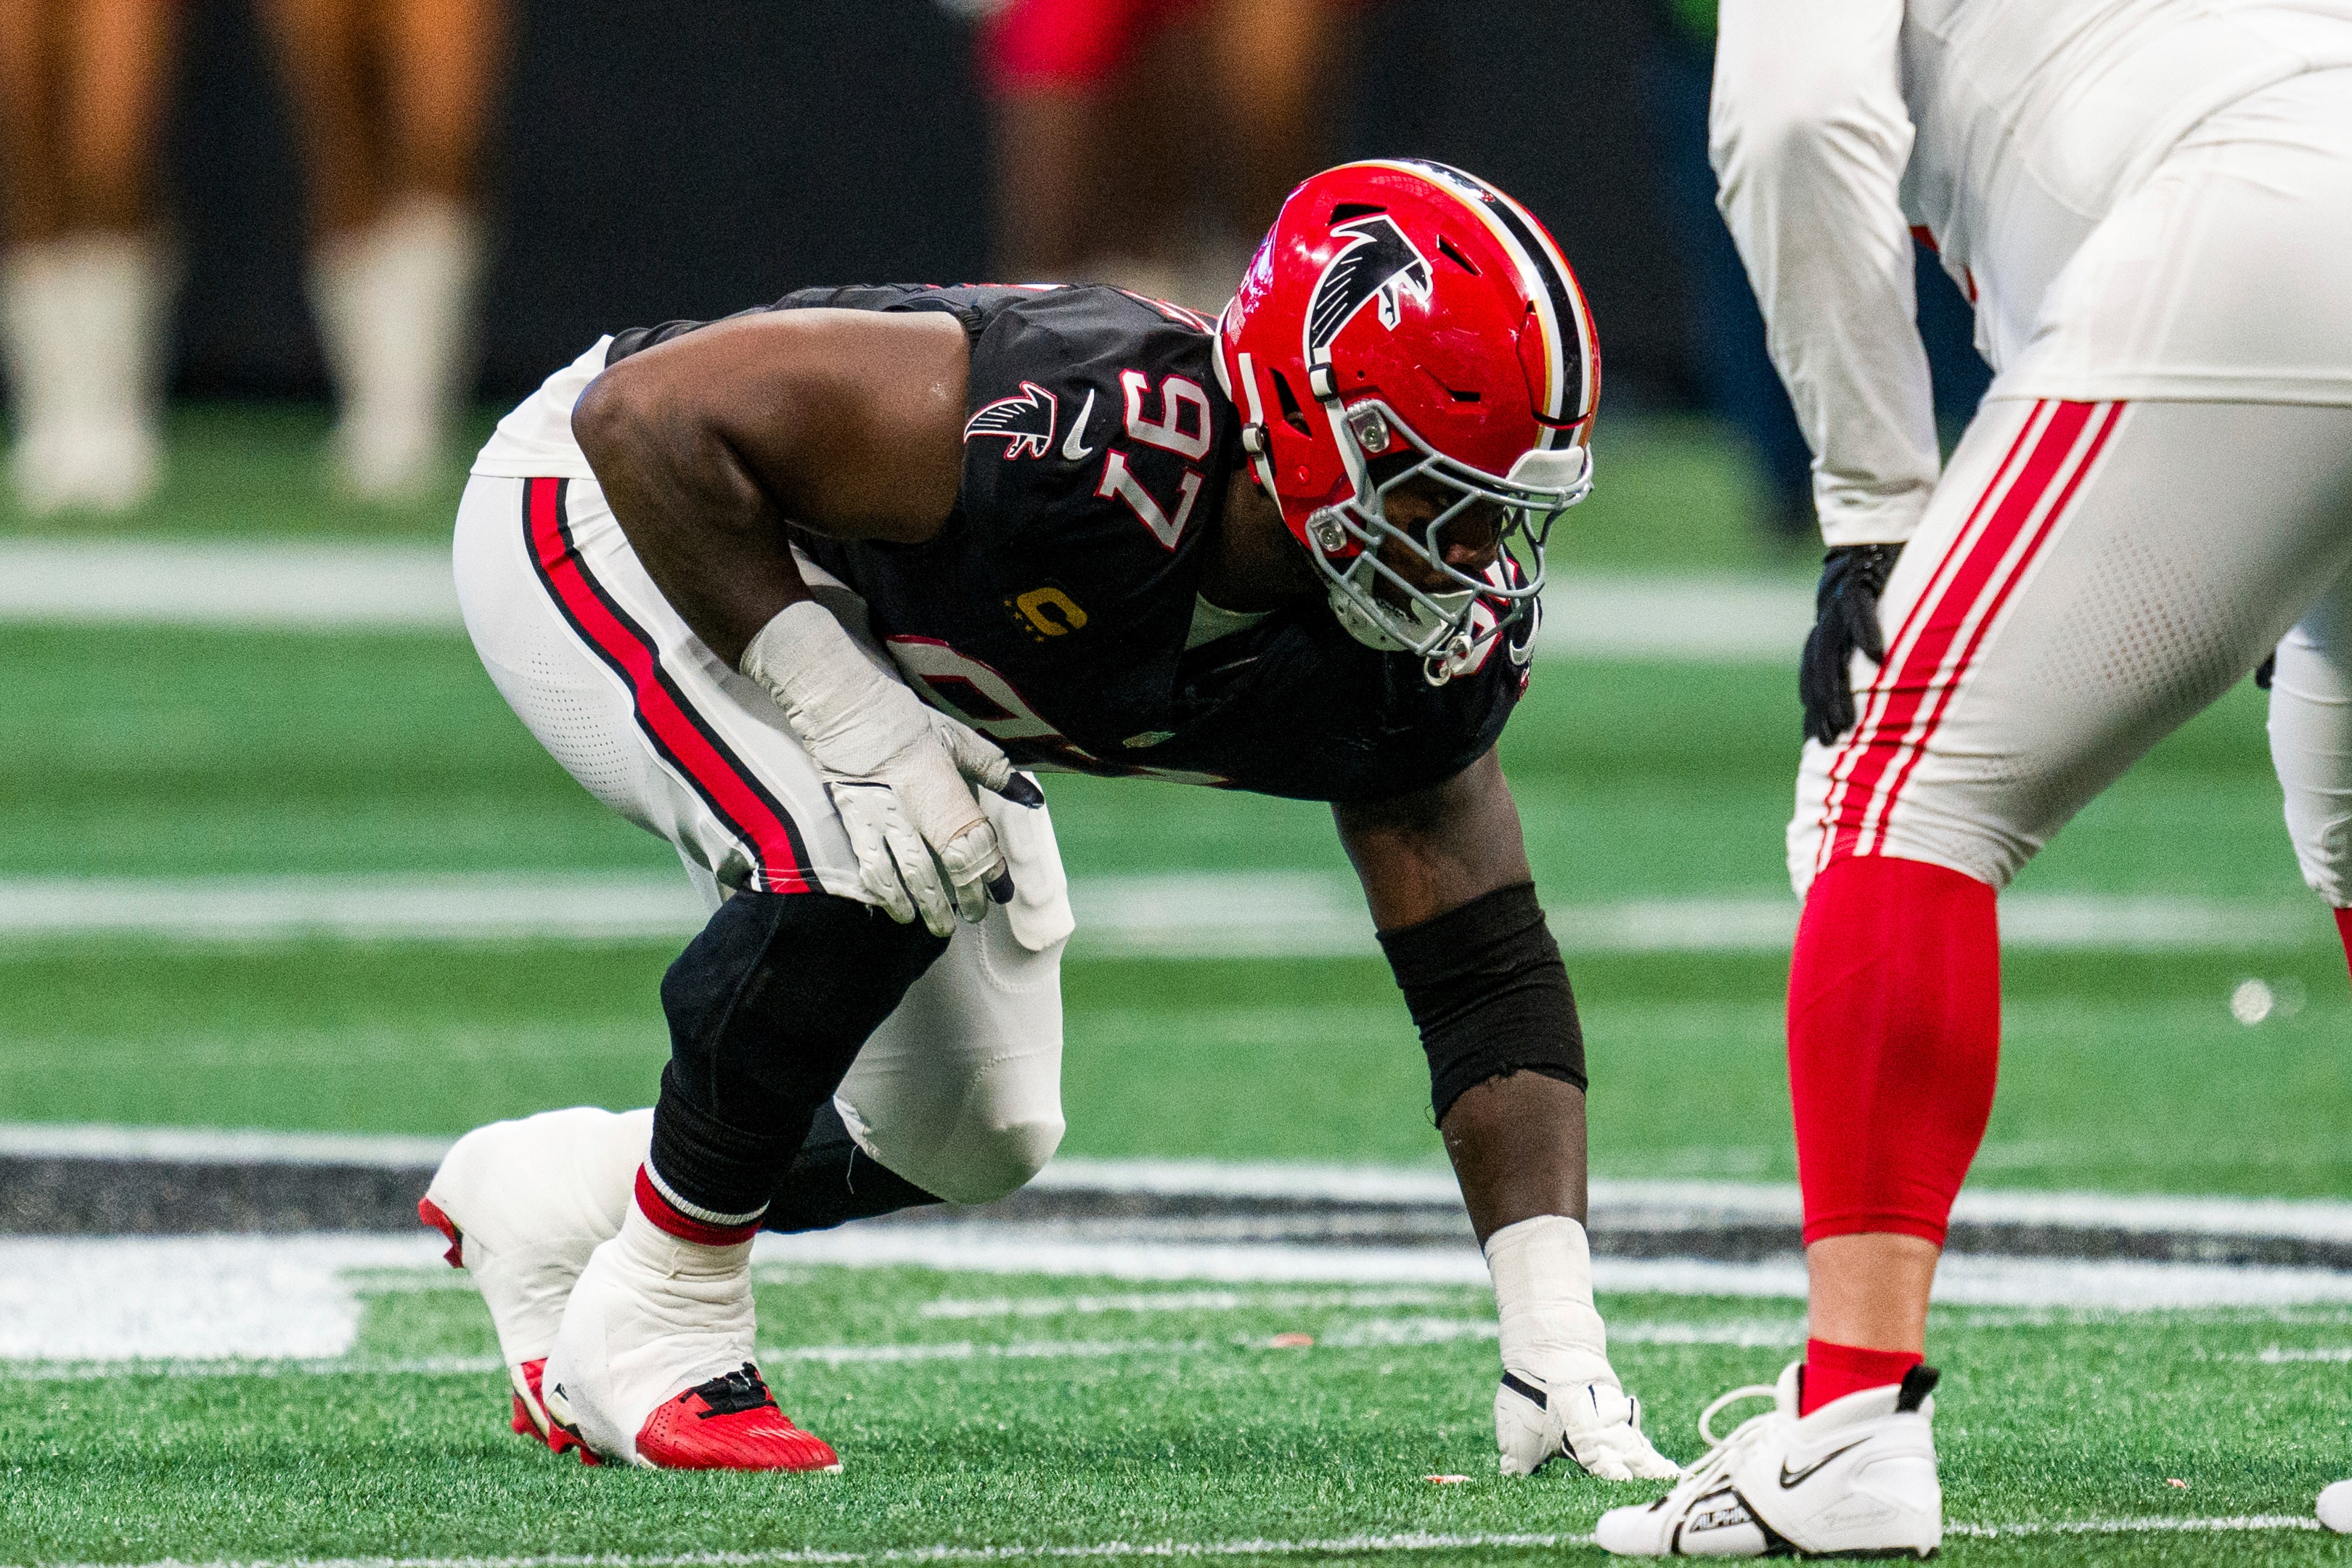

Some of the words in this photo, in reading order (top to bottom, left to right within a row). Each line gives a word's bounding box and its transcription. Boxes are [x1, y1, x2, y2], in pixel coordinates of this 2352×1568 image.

[1094, 369, 1212, 552] 97
[1016, 587, 1088, 637] C
[1689, 1506, 1752, 1533] ALPHA
